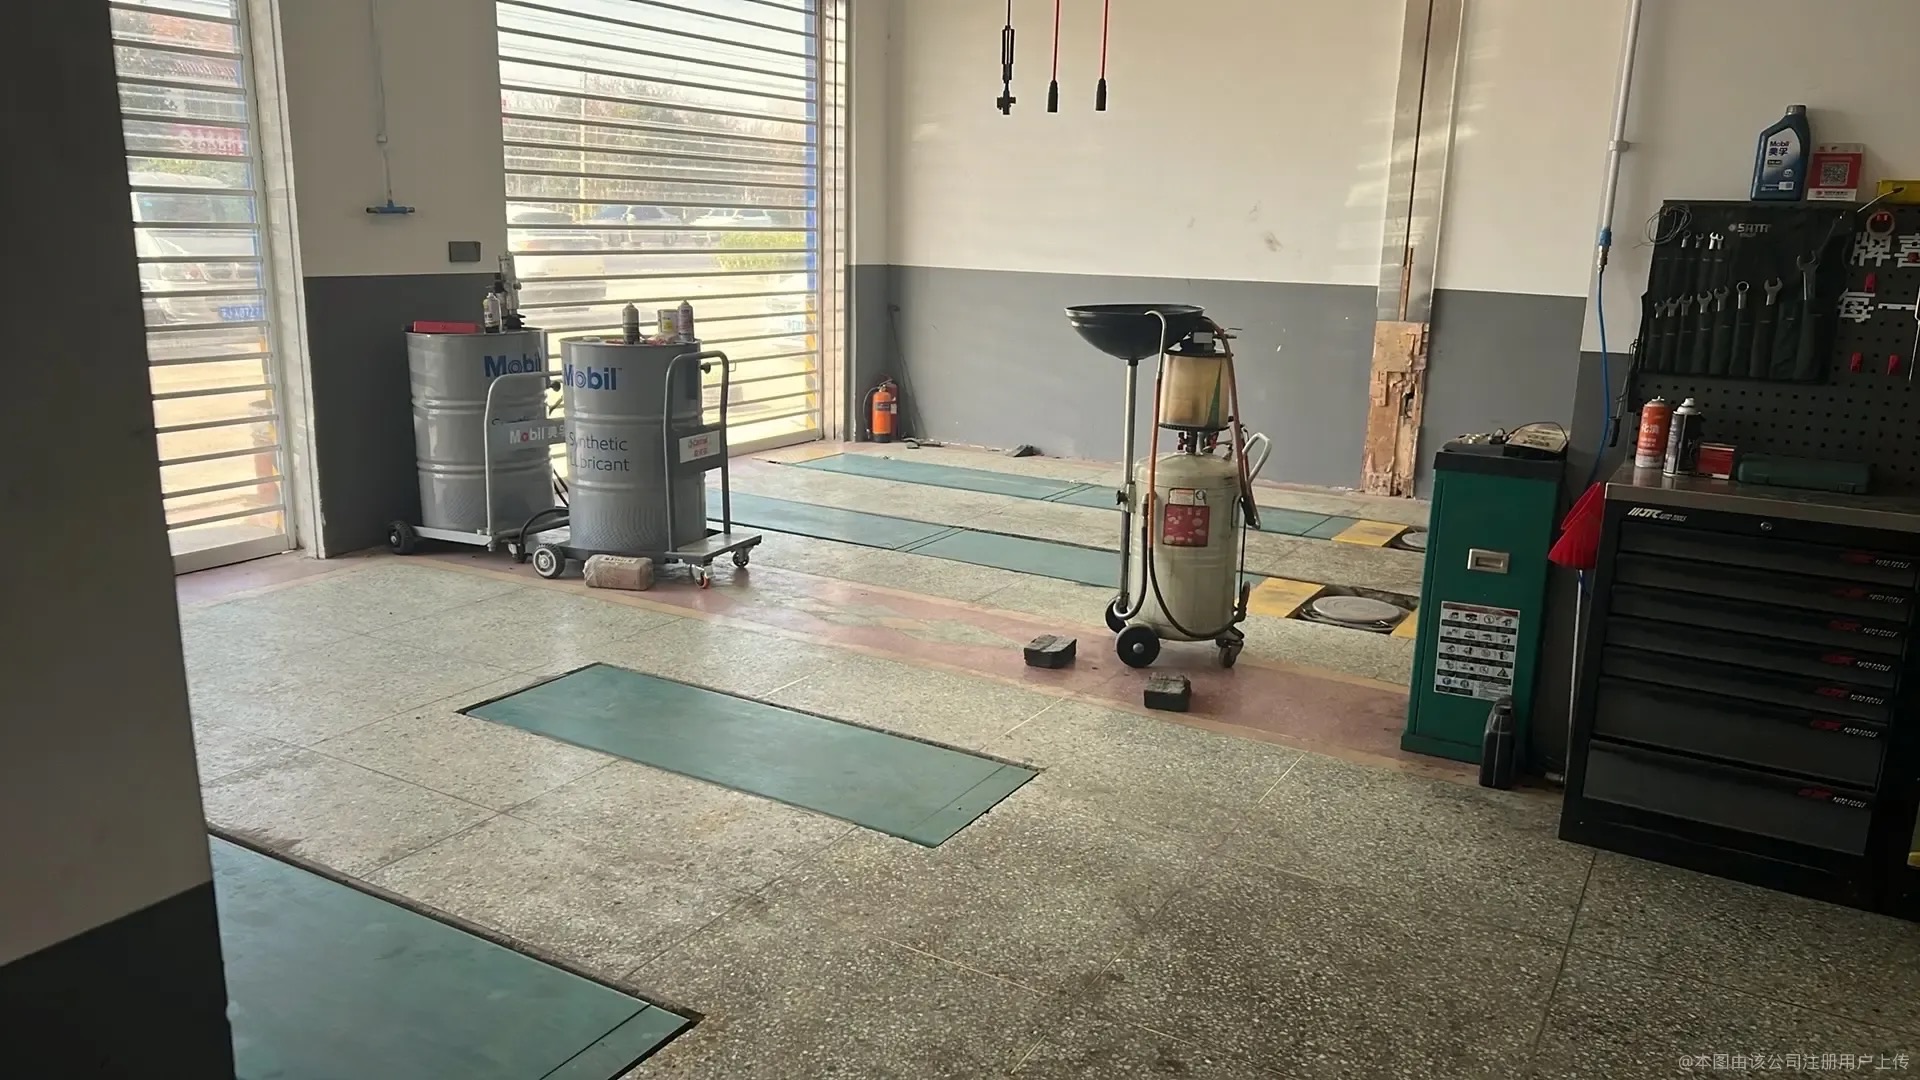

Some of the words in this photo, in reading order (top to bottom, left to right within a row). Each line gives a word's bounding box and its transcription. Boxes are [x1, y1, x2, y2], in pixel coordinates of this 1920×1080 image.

[1737, 223, 1769, 232] SATA
[484, 352, 541, 377] Mobil
[564, 364, 618, 390] Mobil
[510, 427, 545, 444] Mobil
[569, 432, 628, 451] Synthetic
[570, 452, 630, 471] Lubricant
